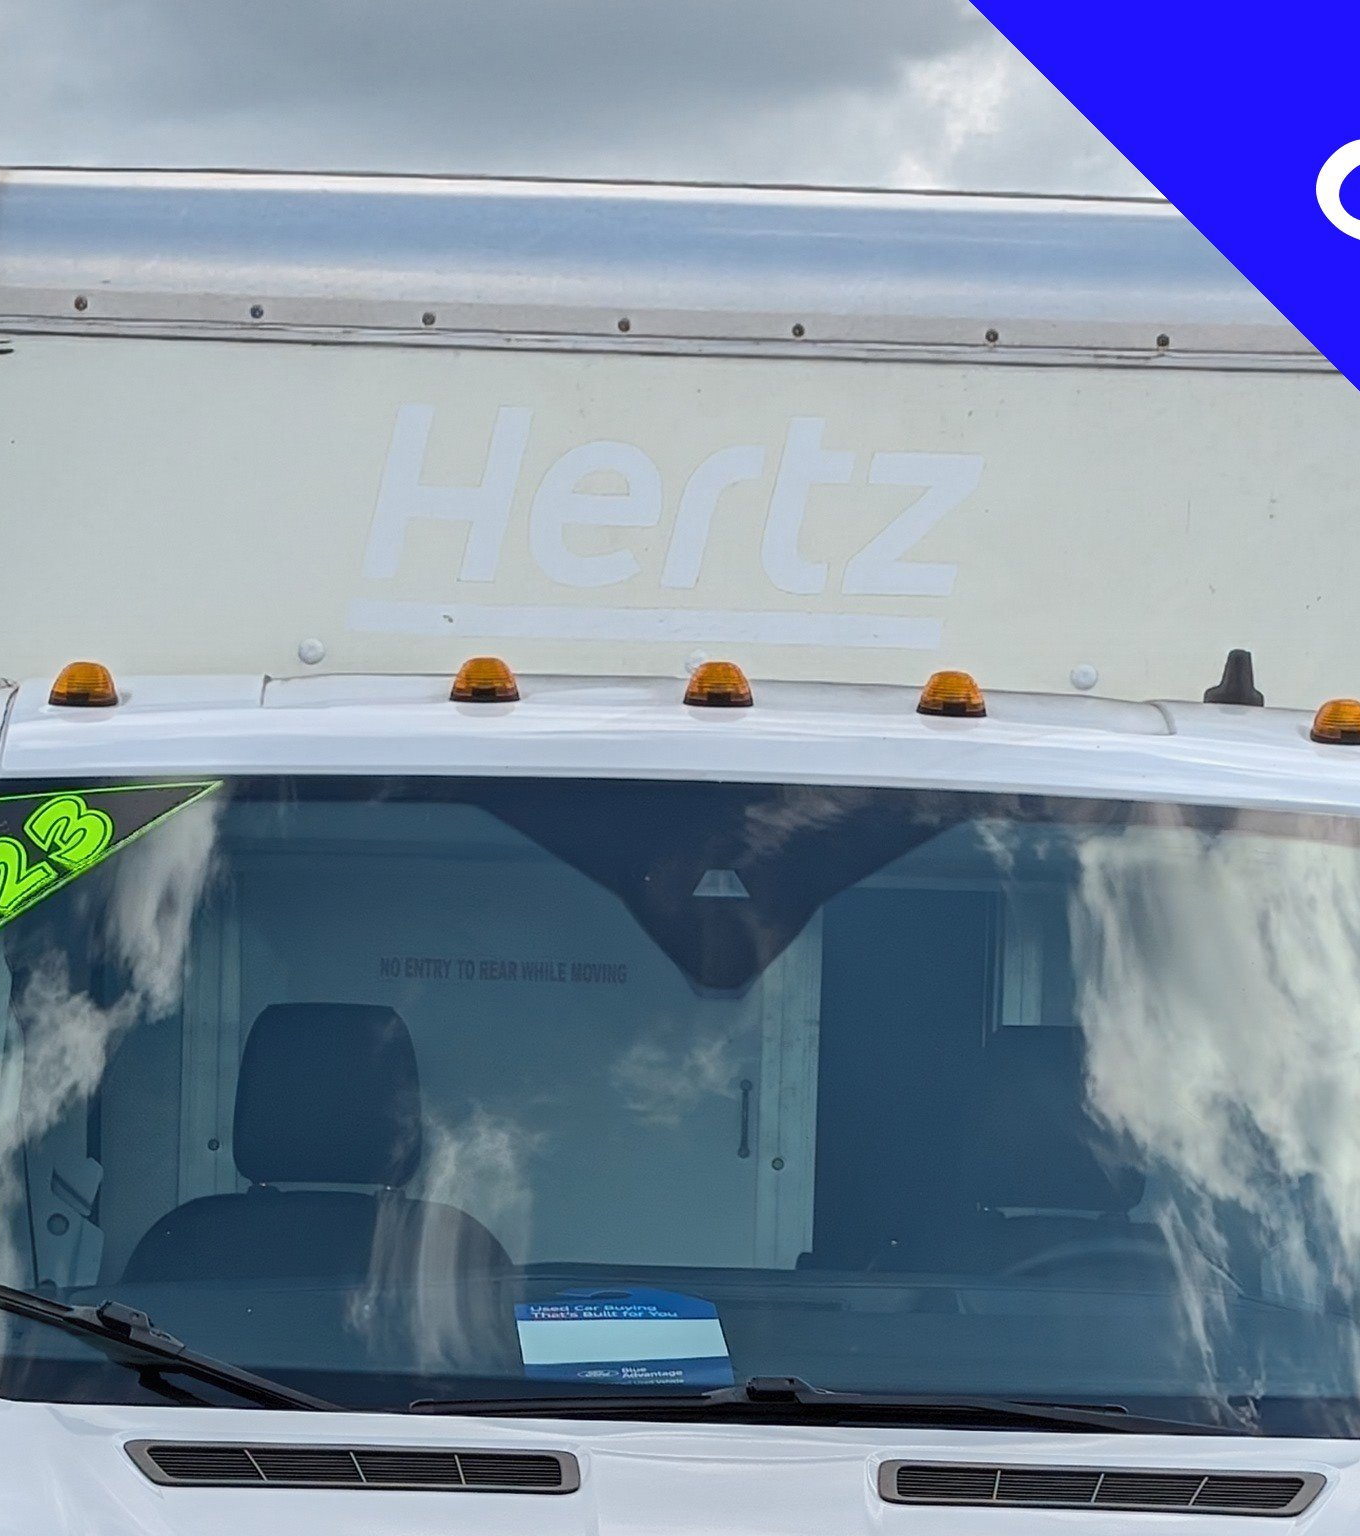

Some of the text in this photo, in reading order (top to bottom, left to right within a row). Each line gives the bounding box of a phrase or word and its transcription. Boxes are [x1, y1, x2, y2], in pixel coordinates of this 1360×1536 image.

[362, 403, 986, 597] Hertz
[380, 957, 628, 985] NO ENTRY TO REAR WHILE MOVING
[603, 1305, 658, 1313] Buying
[622, 1370, 684, 1379] Advantage
